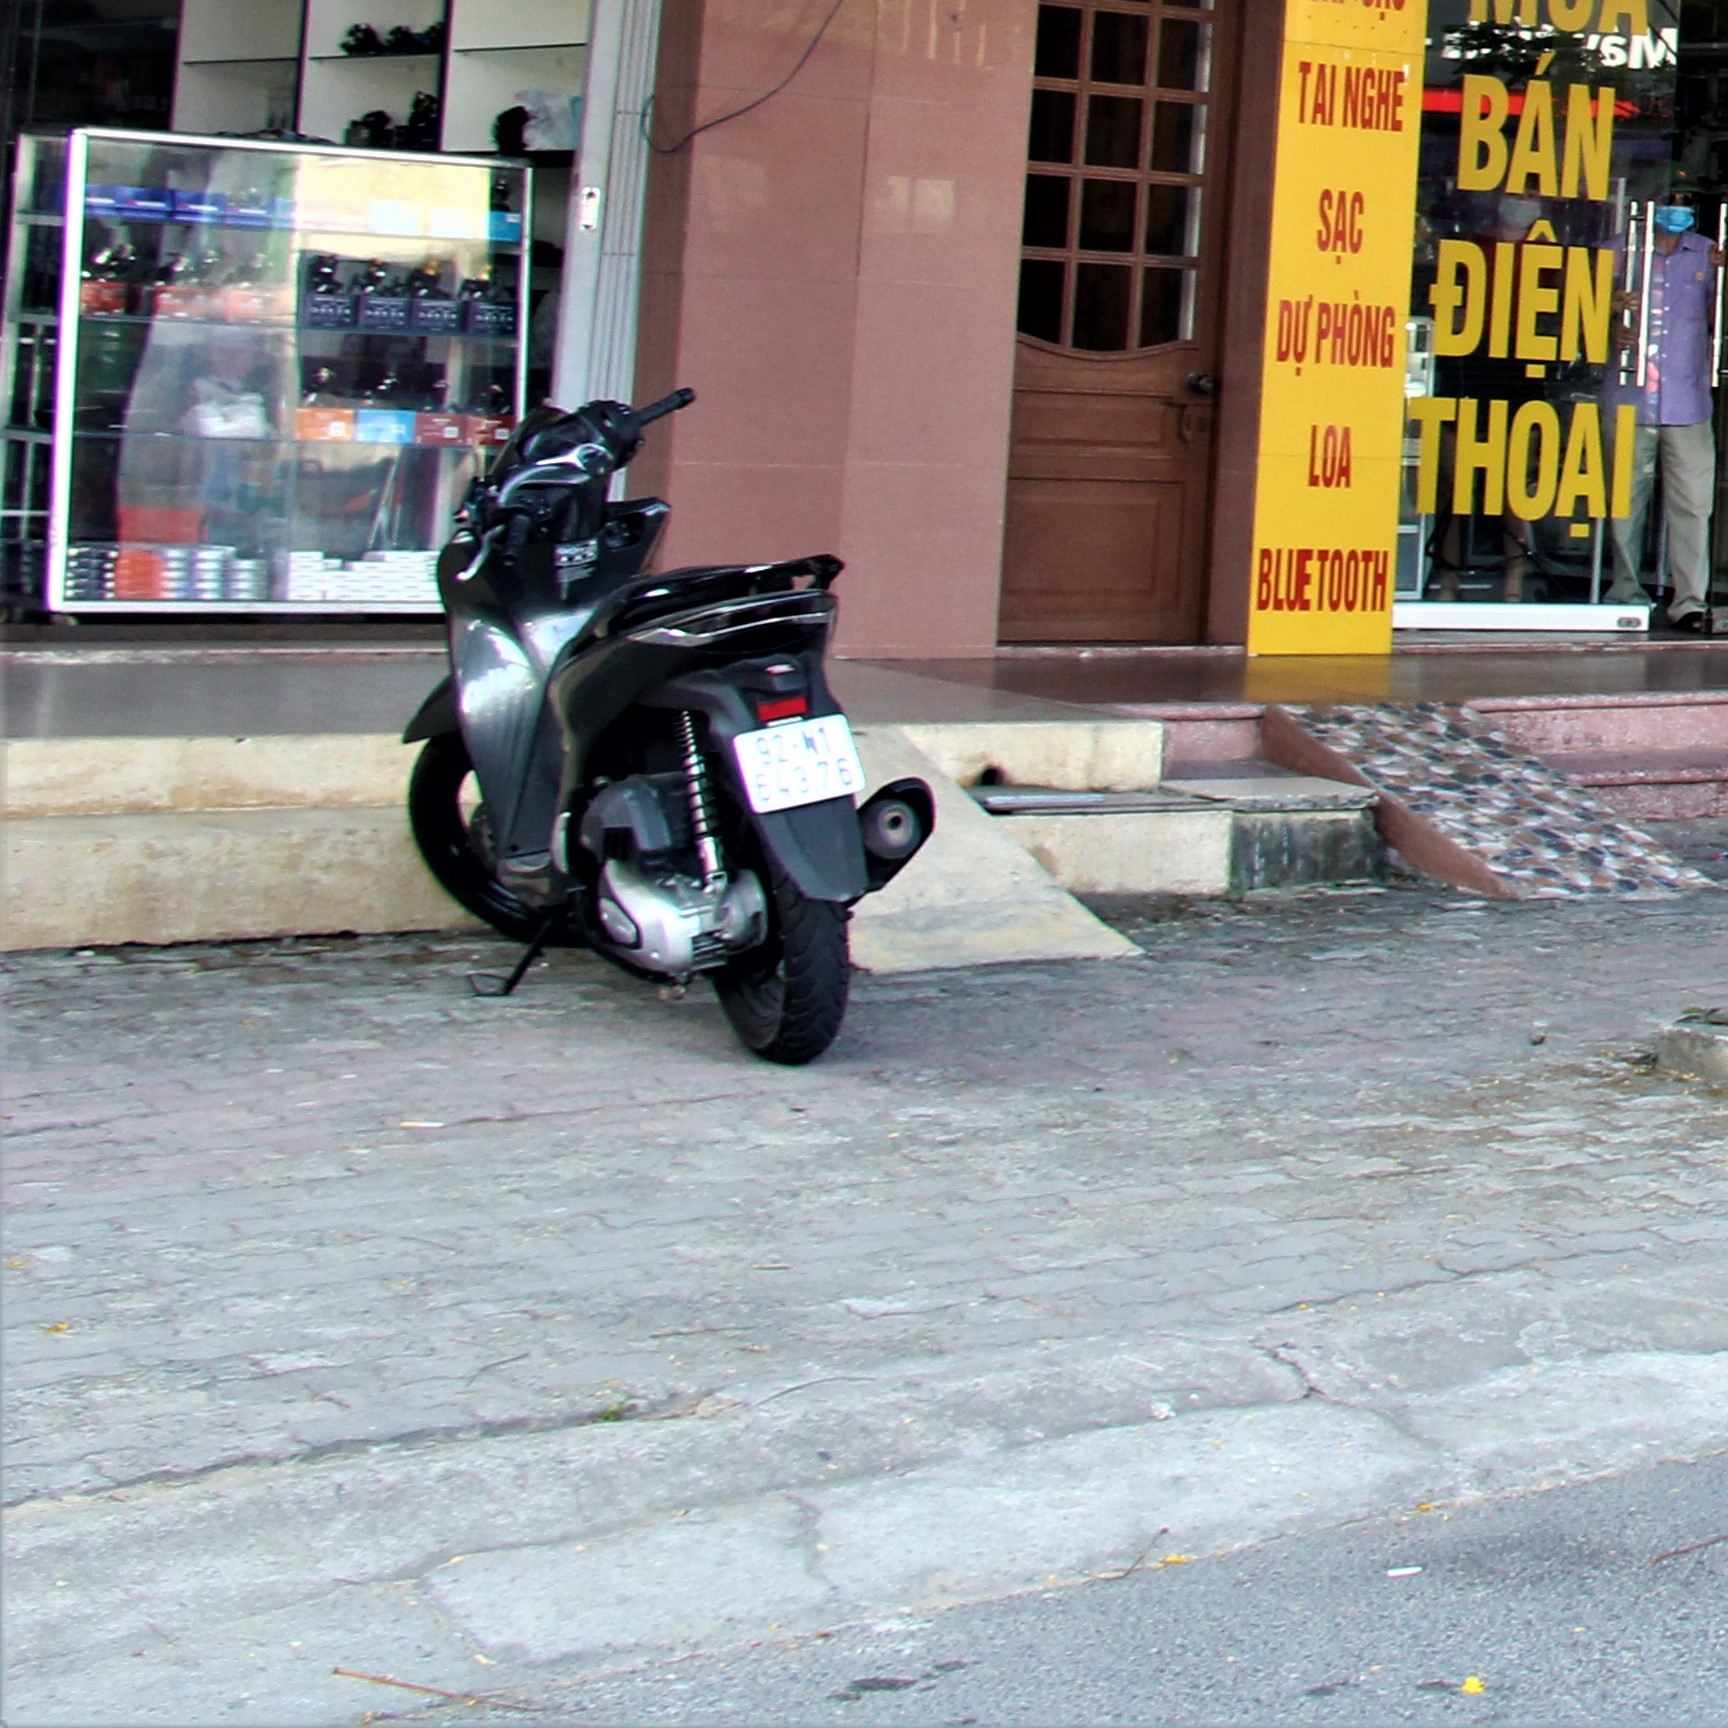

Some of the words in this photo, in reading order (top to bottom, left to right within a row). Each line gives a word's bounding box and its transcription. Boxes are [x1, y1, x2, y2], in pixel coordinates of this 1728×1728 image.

[1298, 61, 1335, 126] TAI
[1341, 64, 1405, 133] NGHE
[1457, 52, 1614, 201] BÁN
[1316, 188, 1364, 265] SẠC
[1276, 295, 1314, 377] DỰ
[1314, 290, 1396, 369] PHÒNG
[1429, 220, 1615, 378] ĐIỆN
[1307, 424, 1352, 489] LOA
[1409, 397, 1636, 538] THOẠI
